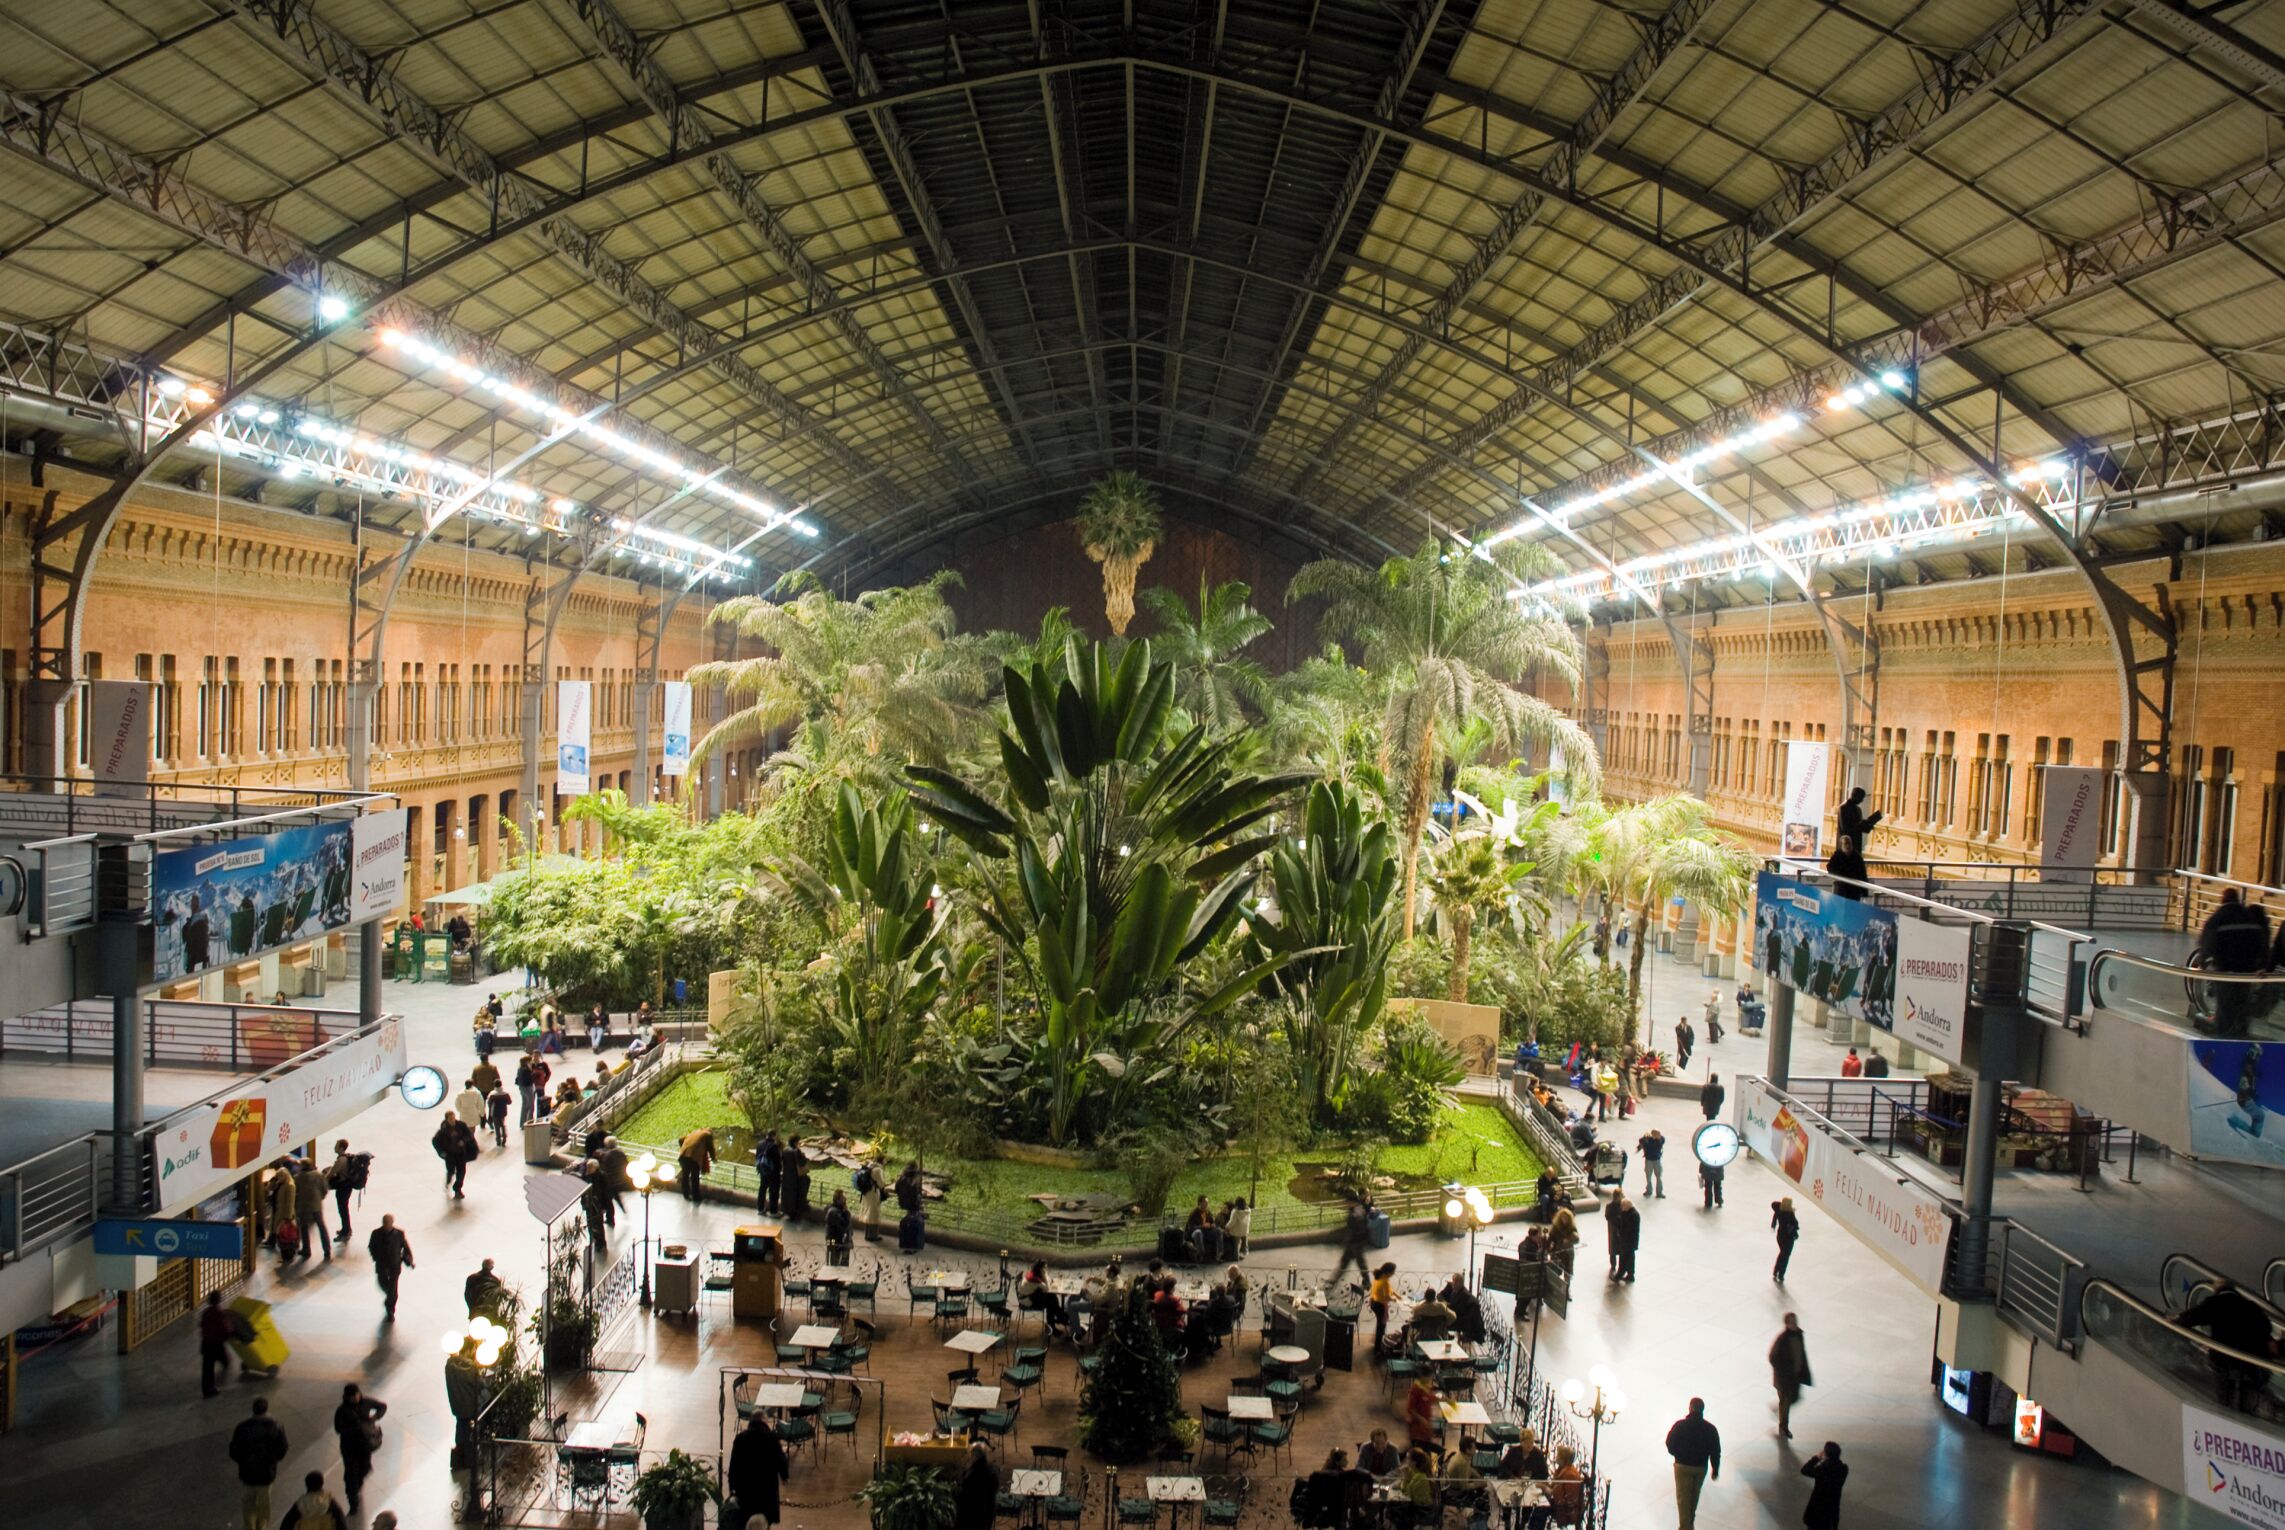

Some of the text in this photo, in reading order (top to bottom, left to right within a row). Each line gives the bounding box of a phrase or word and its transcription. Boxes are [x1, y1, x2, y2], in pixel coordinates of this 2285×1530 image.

[106, 697, 139, 775] PREPARADOS
[2053, 783, 2091, 861] PREPARADOS
[360, 834, 400, 864] PREPARADOS
[370, 878, 397, 896] Andorra
[1906, 959, 1959, 979] PREPARADOS
[1917, 1005, 1951, 1032] Andorra
[176, 1145, 202, 1169] adif
[1868, 1194, 1918, 1246] NAVIDAD
[184, 1229, 209, 1241] Taxi
